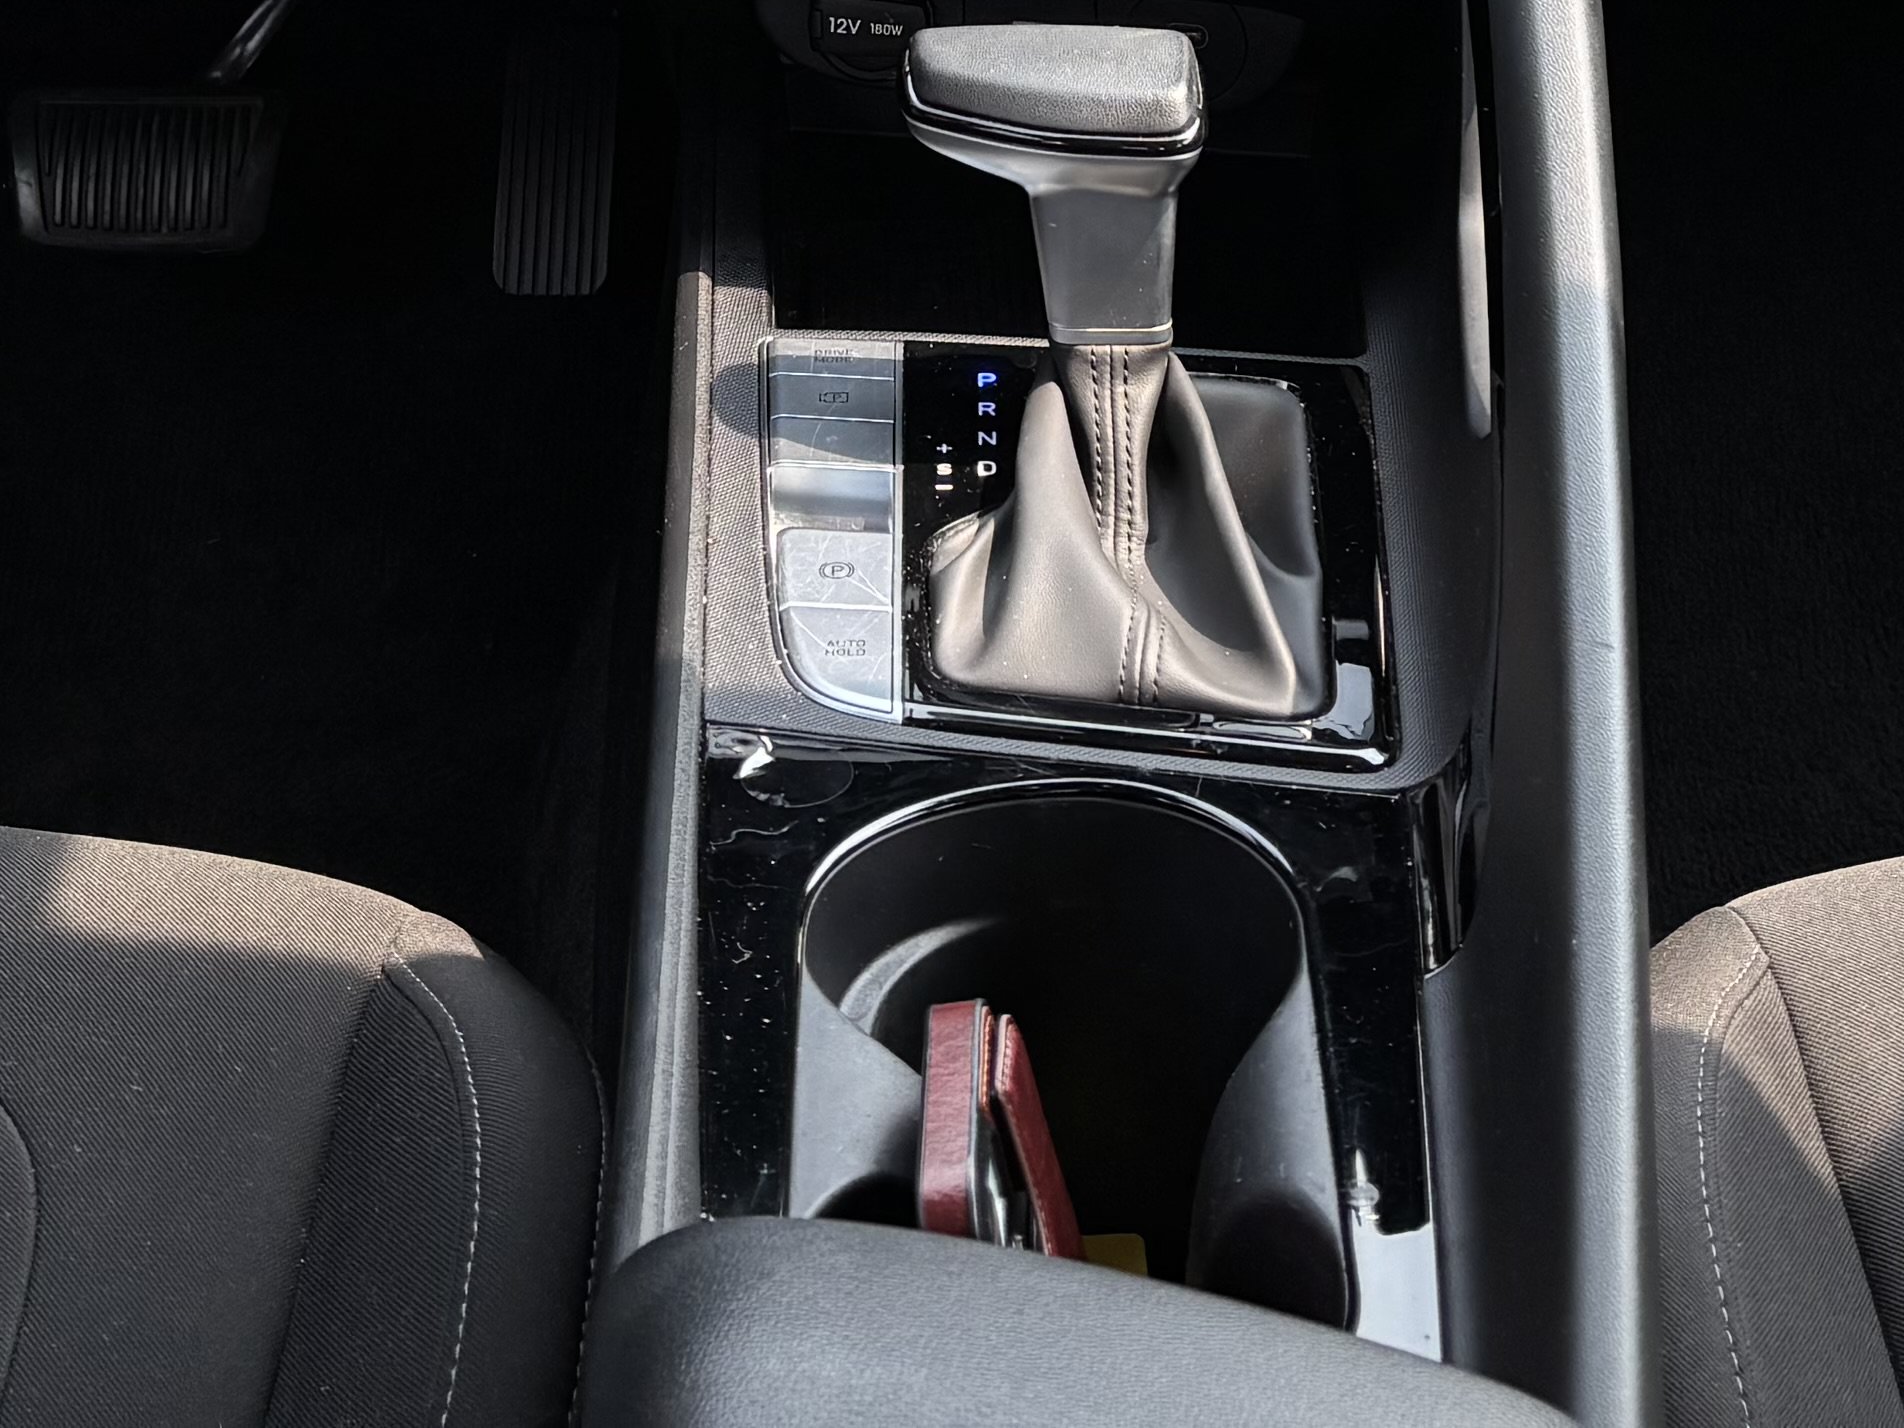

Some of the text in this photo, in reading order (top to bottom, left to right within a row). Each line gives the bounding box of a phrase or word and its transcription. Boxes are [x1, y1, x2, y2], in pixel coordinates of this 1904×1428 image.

[828, 16, 904, 37] 12V 180W
[977, 372, 997, 387] P
[977, 401, 996, 416] R
[977, 431, 997, 446] N
[936, 463, 953, 476] S
[977, 460, 997, 477] D
[826, 639, 866, 647] AUTO
